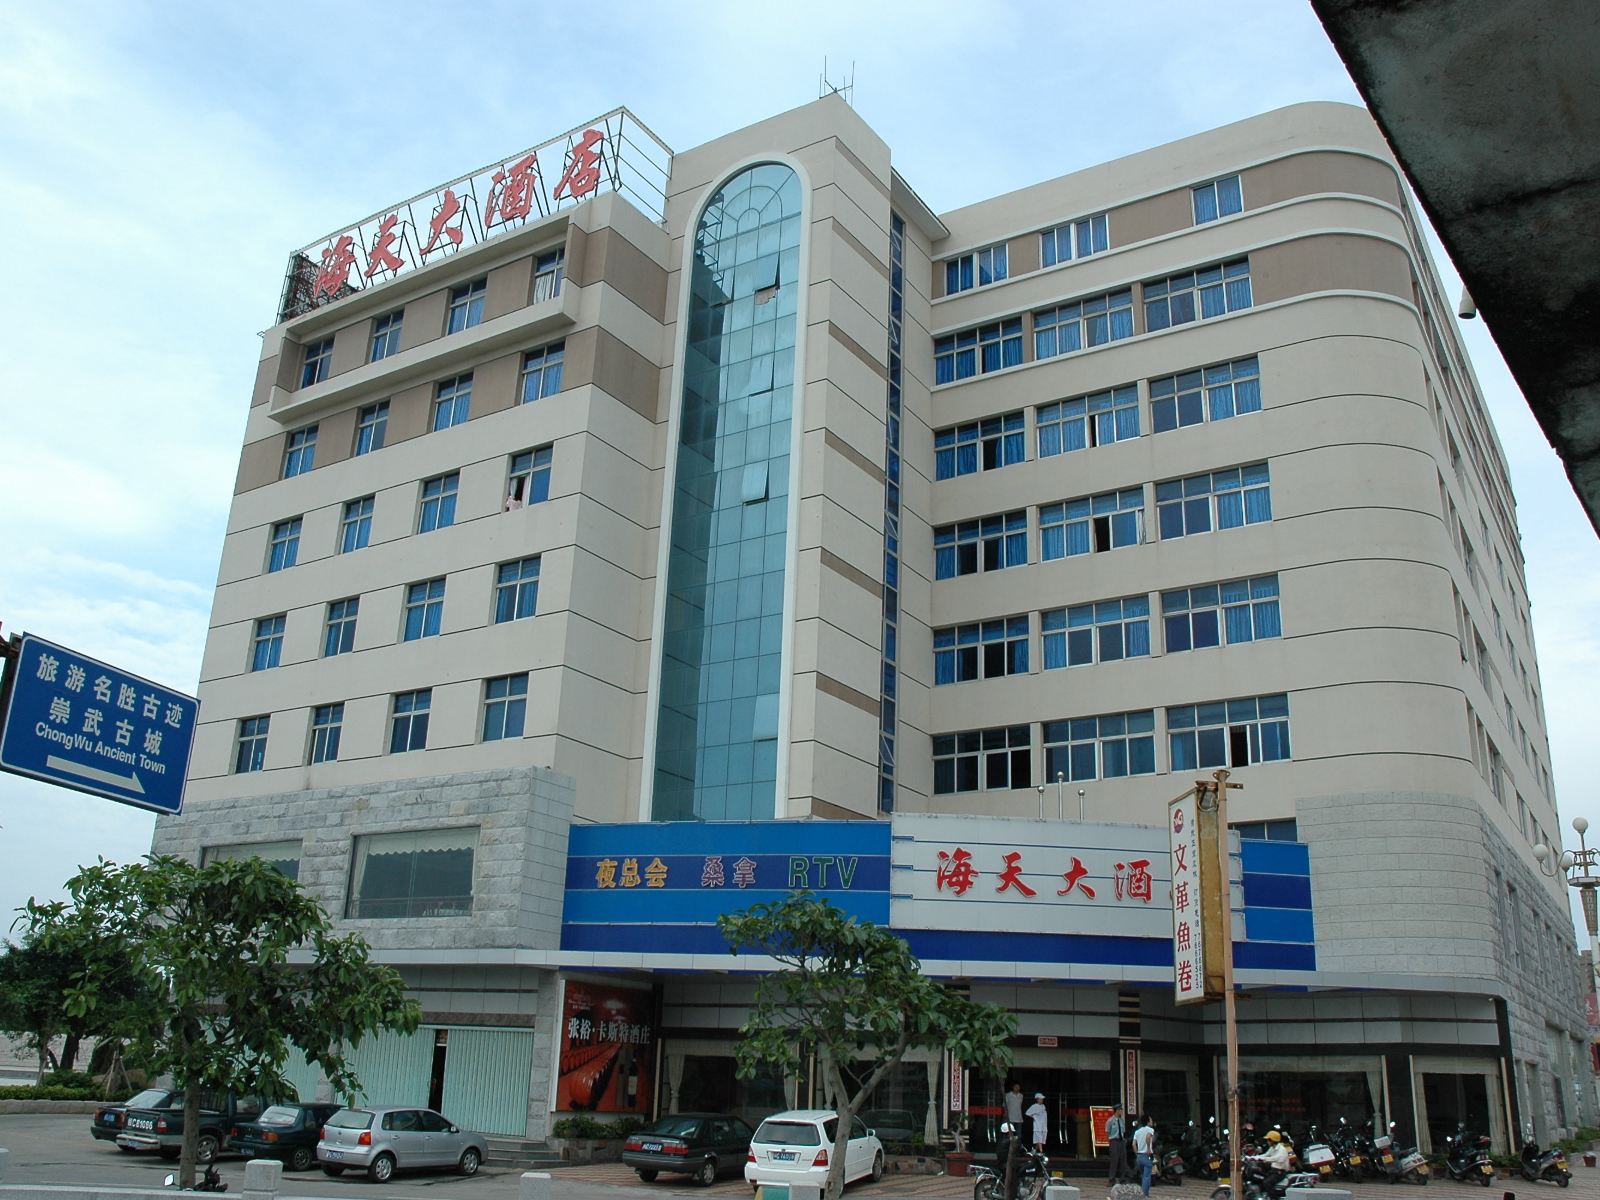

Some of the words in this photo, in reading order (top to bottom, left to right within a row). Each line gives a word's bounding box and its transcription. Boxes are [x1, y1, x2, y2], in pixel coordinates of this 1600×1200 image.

[313, 128, 604, 297] 海天大酒店
[36, 653, 184, 729] 旅游名胜古迹
[35, 721, 93, 751] ChongWu
[94, 741, 136, 765] Ancient
[139, 755, 166, 775] Town
[49, 697, 163, 756] 崇武古城
[595, 857, 669, 889] 夜总会
[701, 856, 757, 888] 桑拿
[788, 856, 858, 889] RTV
[935, 847, 1172, 904] 海天大酒
